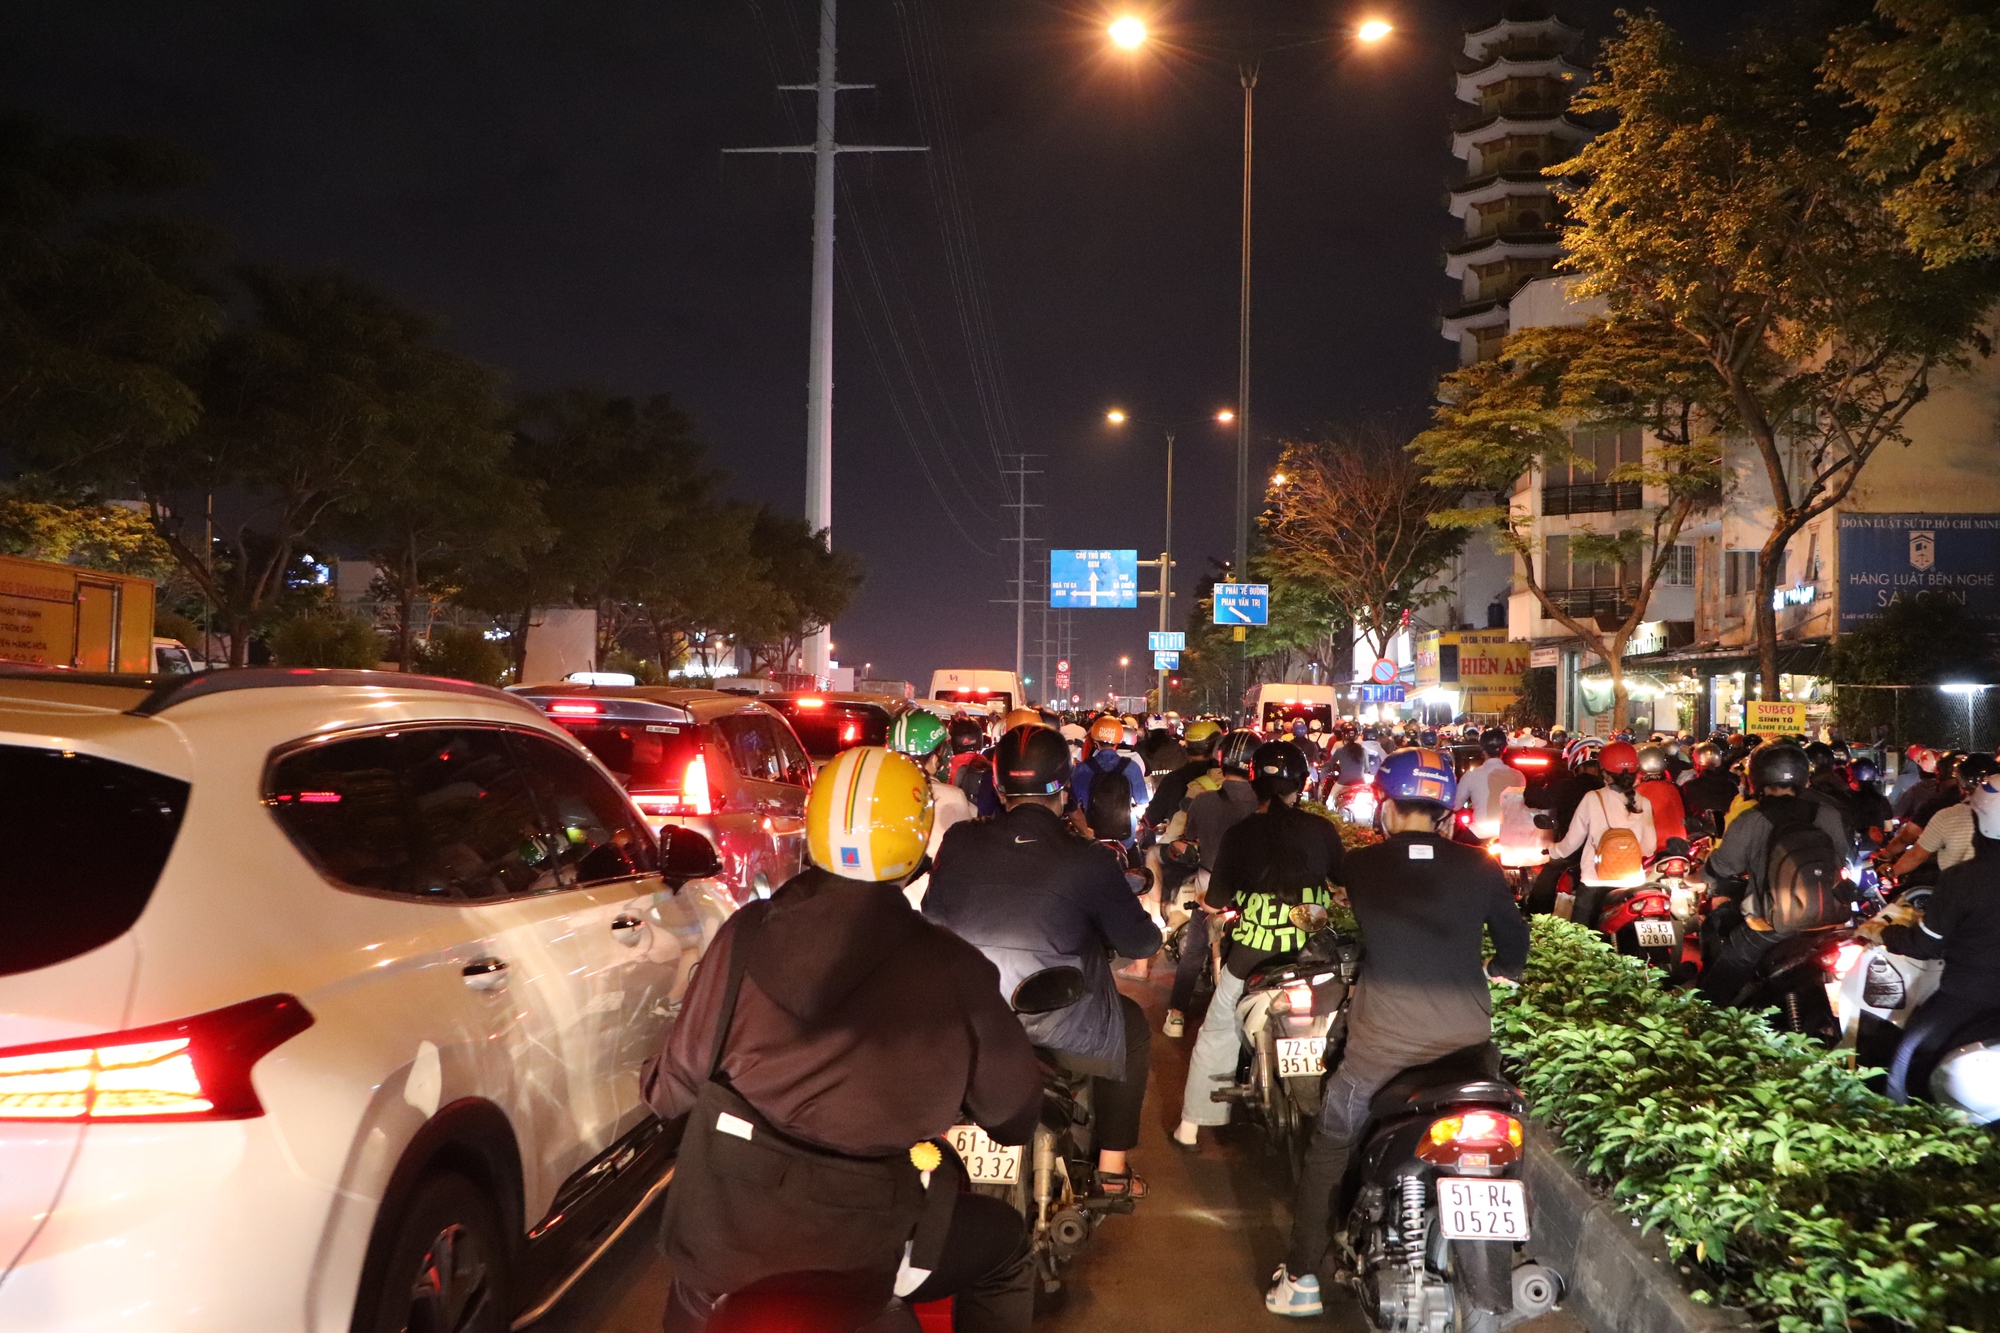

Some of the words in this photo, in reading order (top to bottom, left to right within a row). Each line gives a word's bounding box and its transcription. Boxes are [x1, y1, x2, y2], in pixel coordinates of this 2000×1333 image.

[1841, 517, 1871, 529] ĐOÀN
[1873, 517, 1901, 530] LUẬT
[1952, 517, 1972, 529] CHÍ
[1850, 571, 1889, 585] HÃNG
[1894, 571, 1924, 587] LUẬT
[1221, 598, 1236, 607] PHAN
[1238, 597, 1249, 607] VĂN
[1460, 649, 1499, 676] HIỀN
[1503, 657, 1528, 676] AN
[1640, 923, 1669, 934] 59-X3
[1454, 1210, 1516, 1234] 0525
